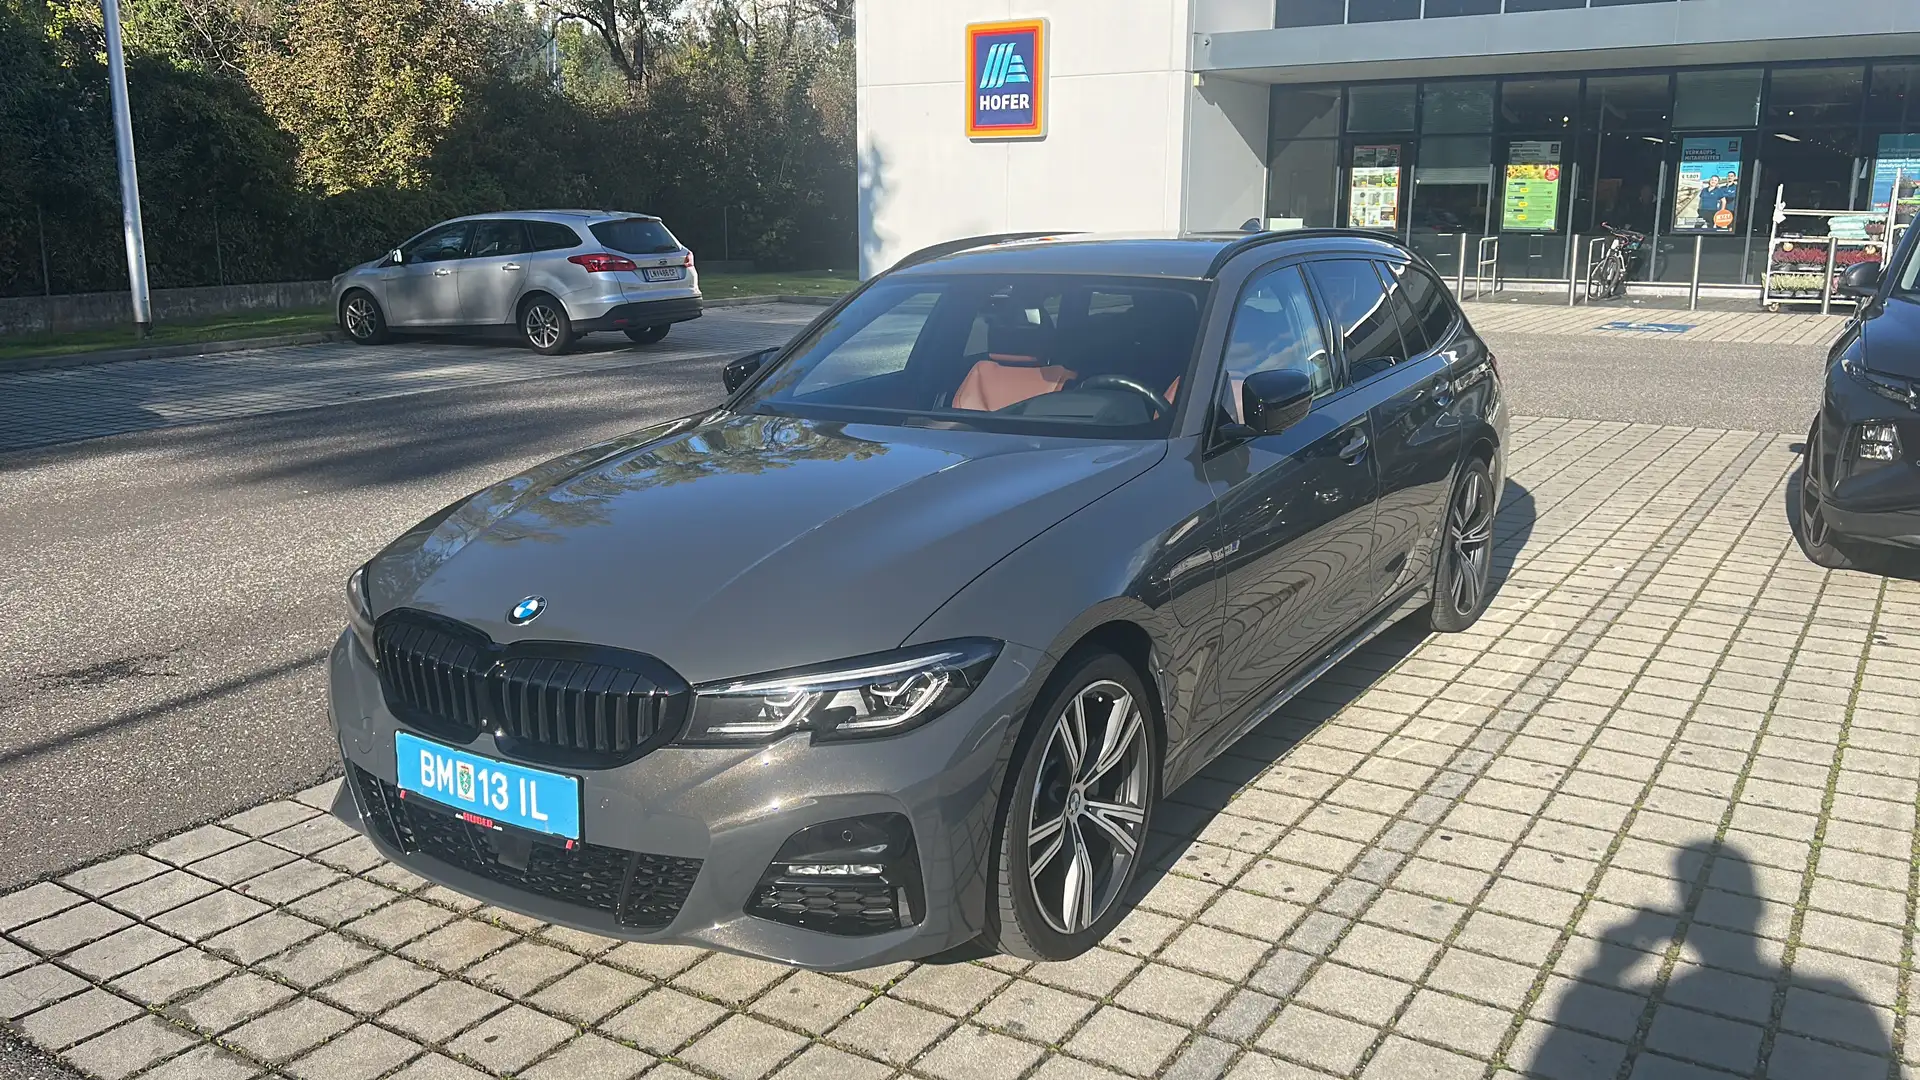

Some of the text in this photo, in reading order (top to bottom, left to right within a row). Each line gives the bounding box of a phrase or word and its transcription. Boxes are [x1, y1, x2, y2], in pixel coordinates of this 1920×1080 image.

[979, 93, 1030, 111] HOFER
[419, 749, 549, 821] BM 13 IL
